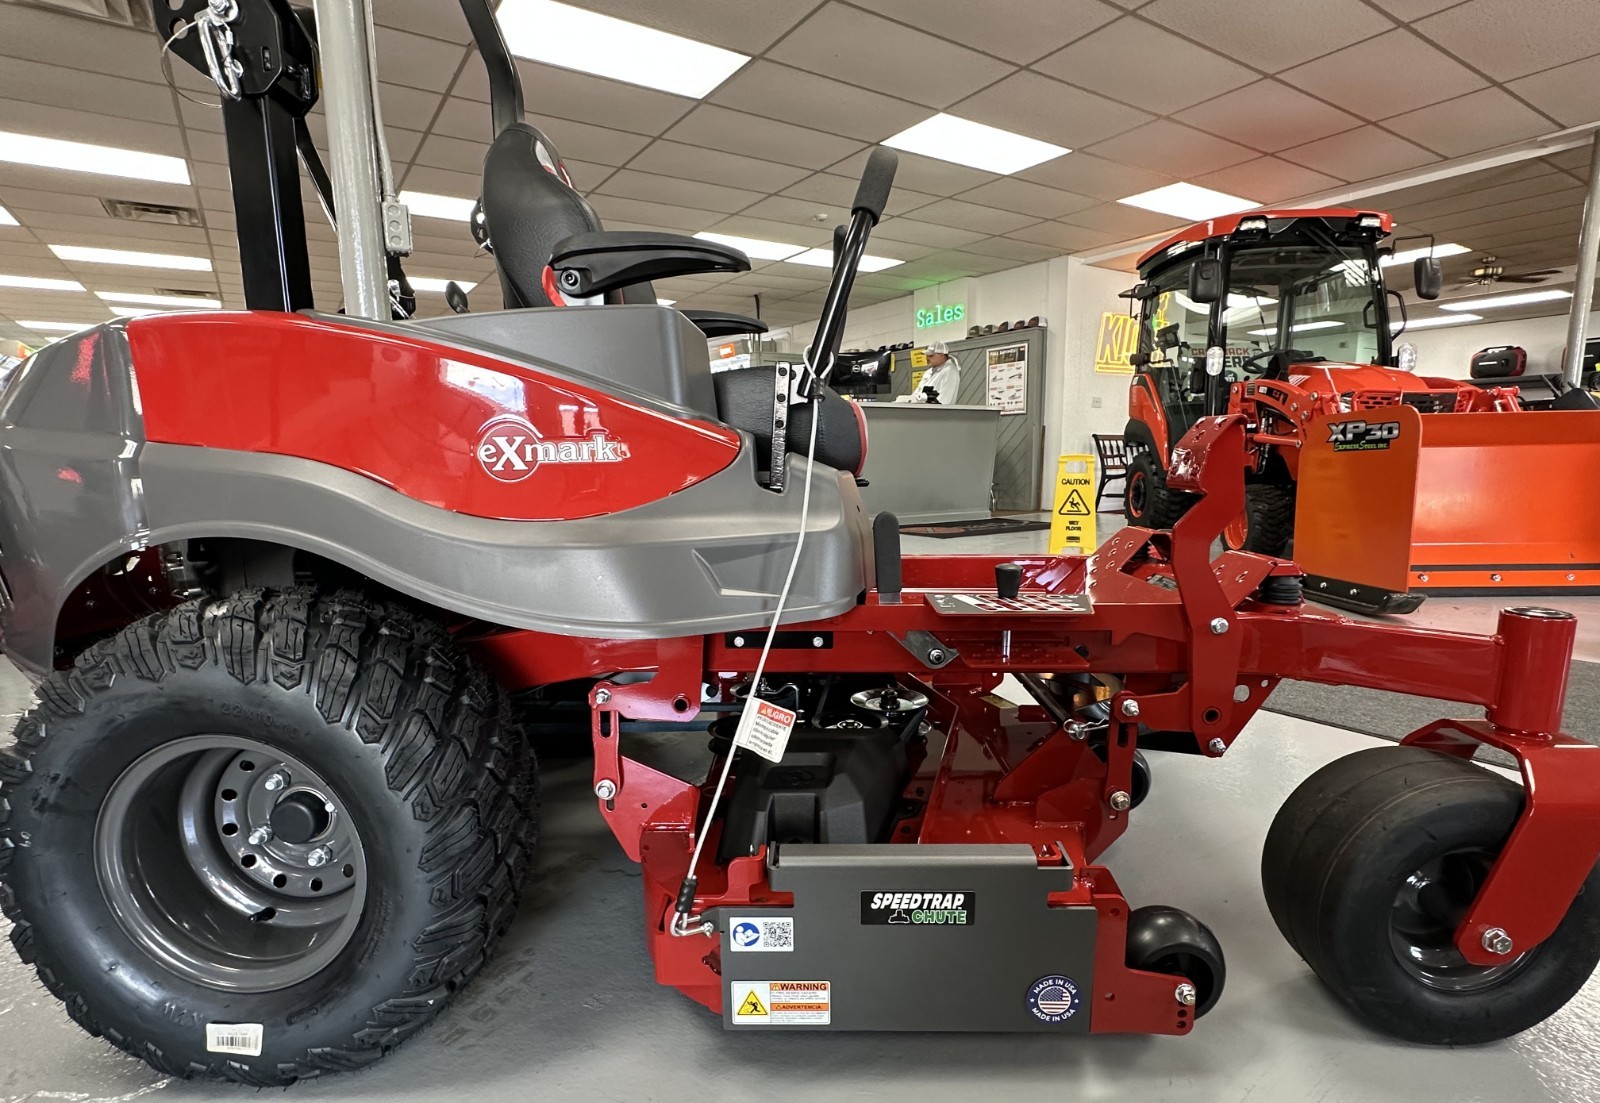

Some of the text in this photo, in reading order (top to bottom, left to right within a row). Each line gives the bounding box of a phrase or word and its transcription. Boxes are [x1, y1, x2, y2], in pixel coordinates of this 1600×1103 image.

[916, 304, 964, 328] Sales
[1327, 421, 1400, 442] XP30
[479, 433, 619, 471] eXmark
[1061, 478, 1090, 486] CAUTION
[870, 892, 965, 910] SPEEDTRAP
[911, 909, 967, 924] CHUTE
[780, 983, 827, 991] WARNING
[1033, 979, 1054, 994] MADE
[1064, 982, 1077, 995] USA
[1031, 1007, 1051, 1021] MADE
[1061, 1008, 1076, 1020] USA
